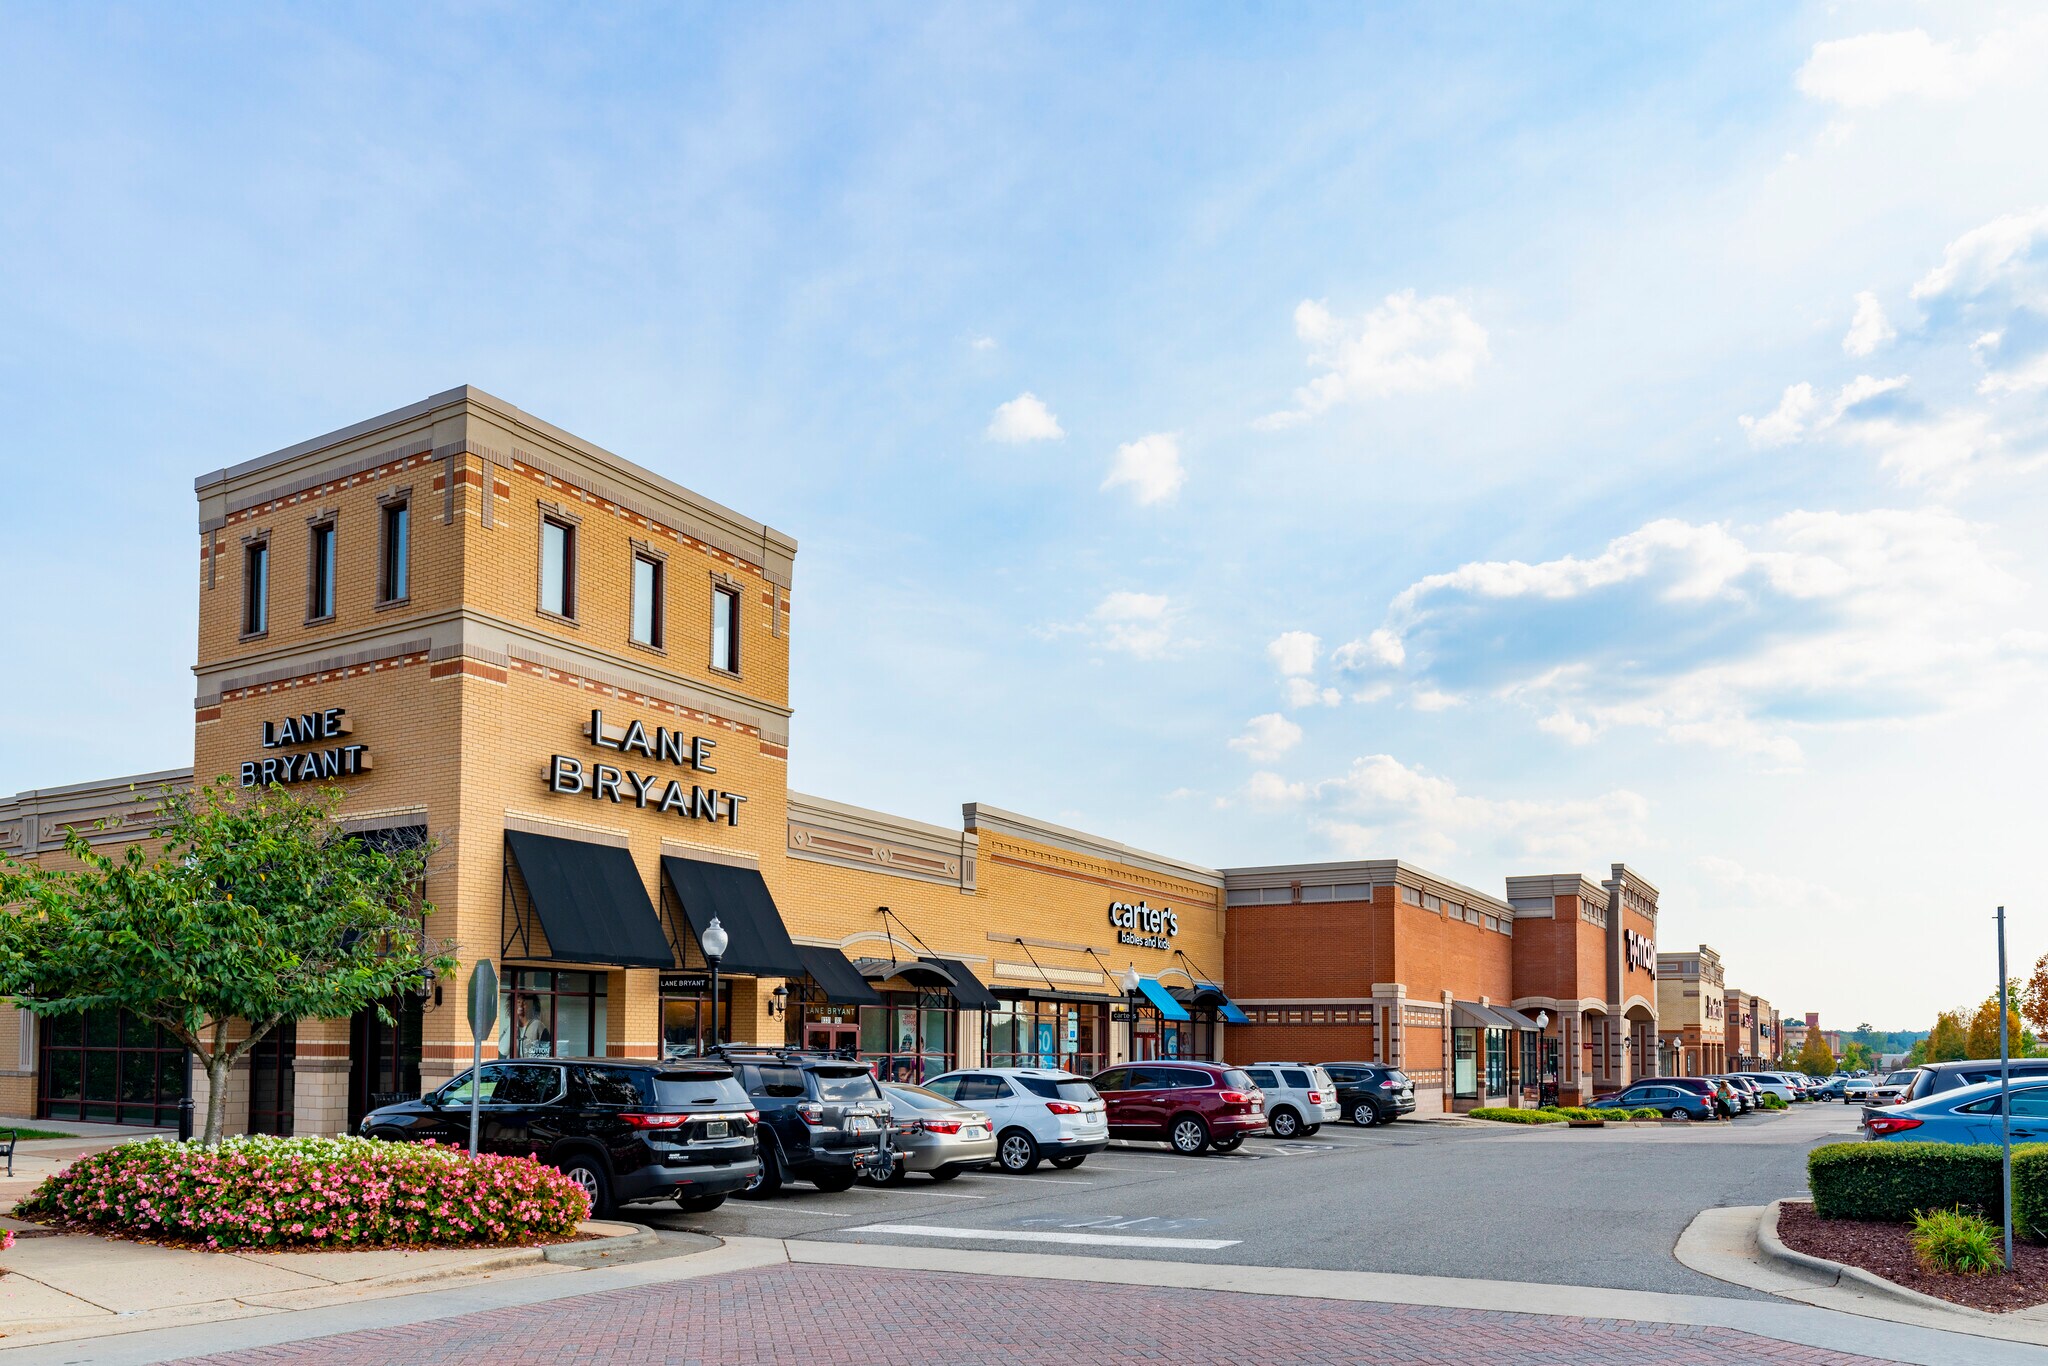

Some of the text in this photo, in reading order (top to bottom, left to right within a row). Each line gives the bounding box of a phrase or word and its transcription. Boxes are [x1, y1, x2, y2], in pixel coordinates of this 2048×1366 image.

[263, 708, 344, 748] LANE
[591, 709, 717, 774] LANE
[241, 745, 367, 788] BRYANT
[551, 755, 747, 826] BRYANT
[1110, 901, 1178, 936] carter's
[1120, 931, 1171, 950] babies and kids
[805, 1006, 855, 1016] LANE BRYANT
